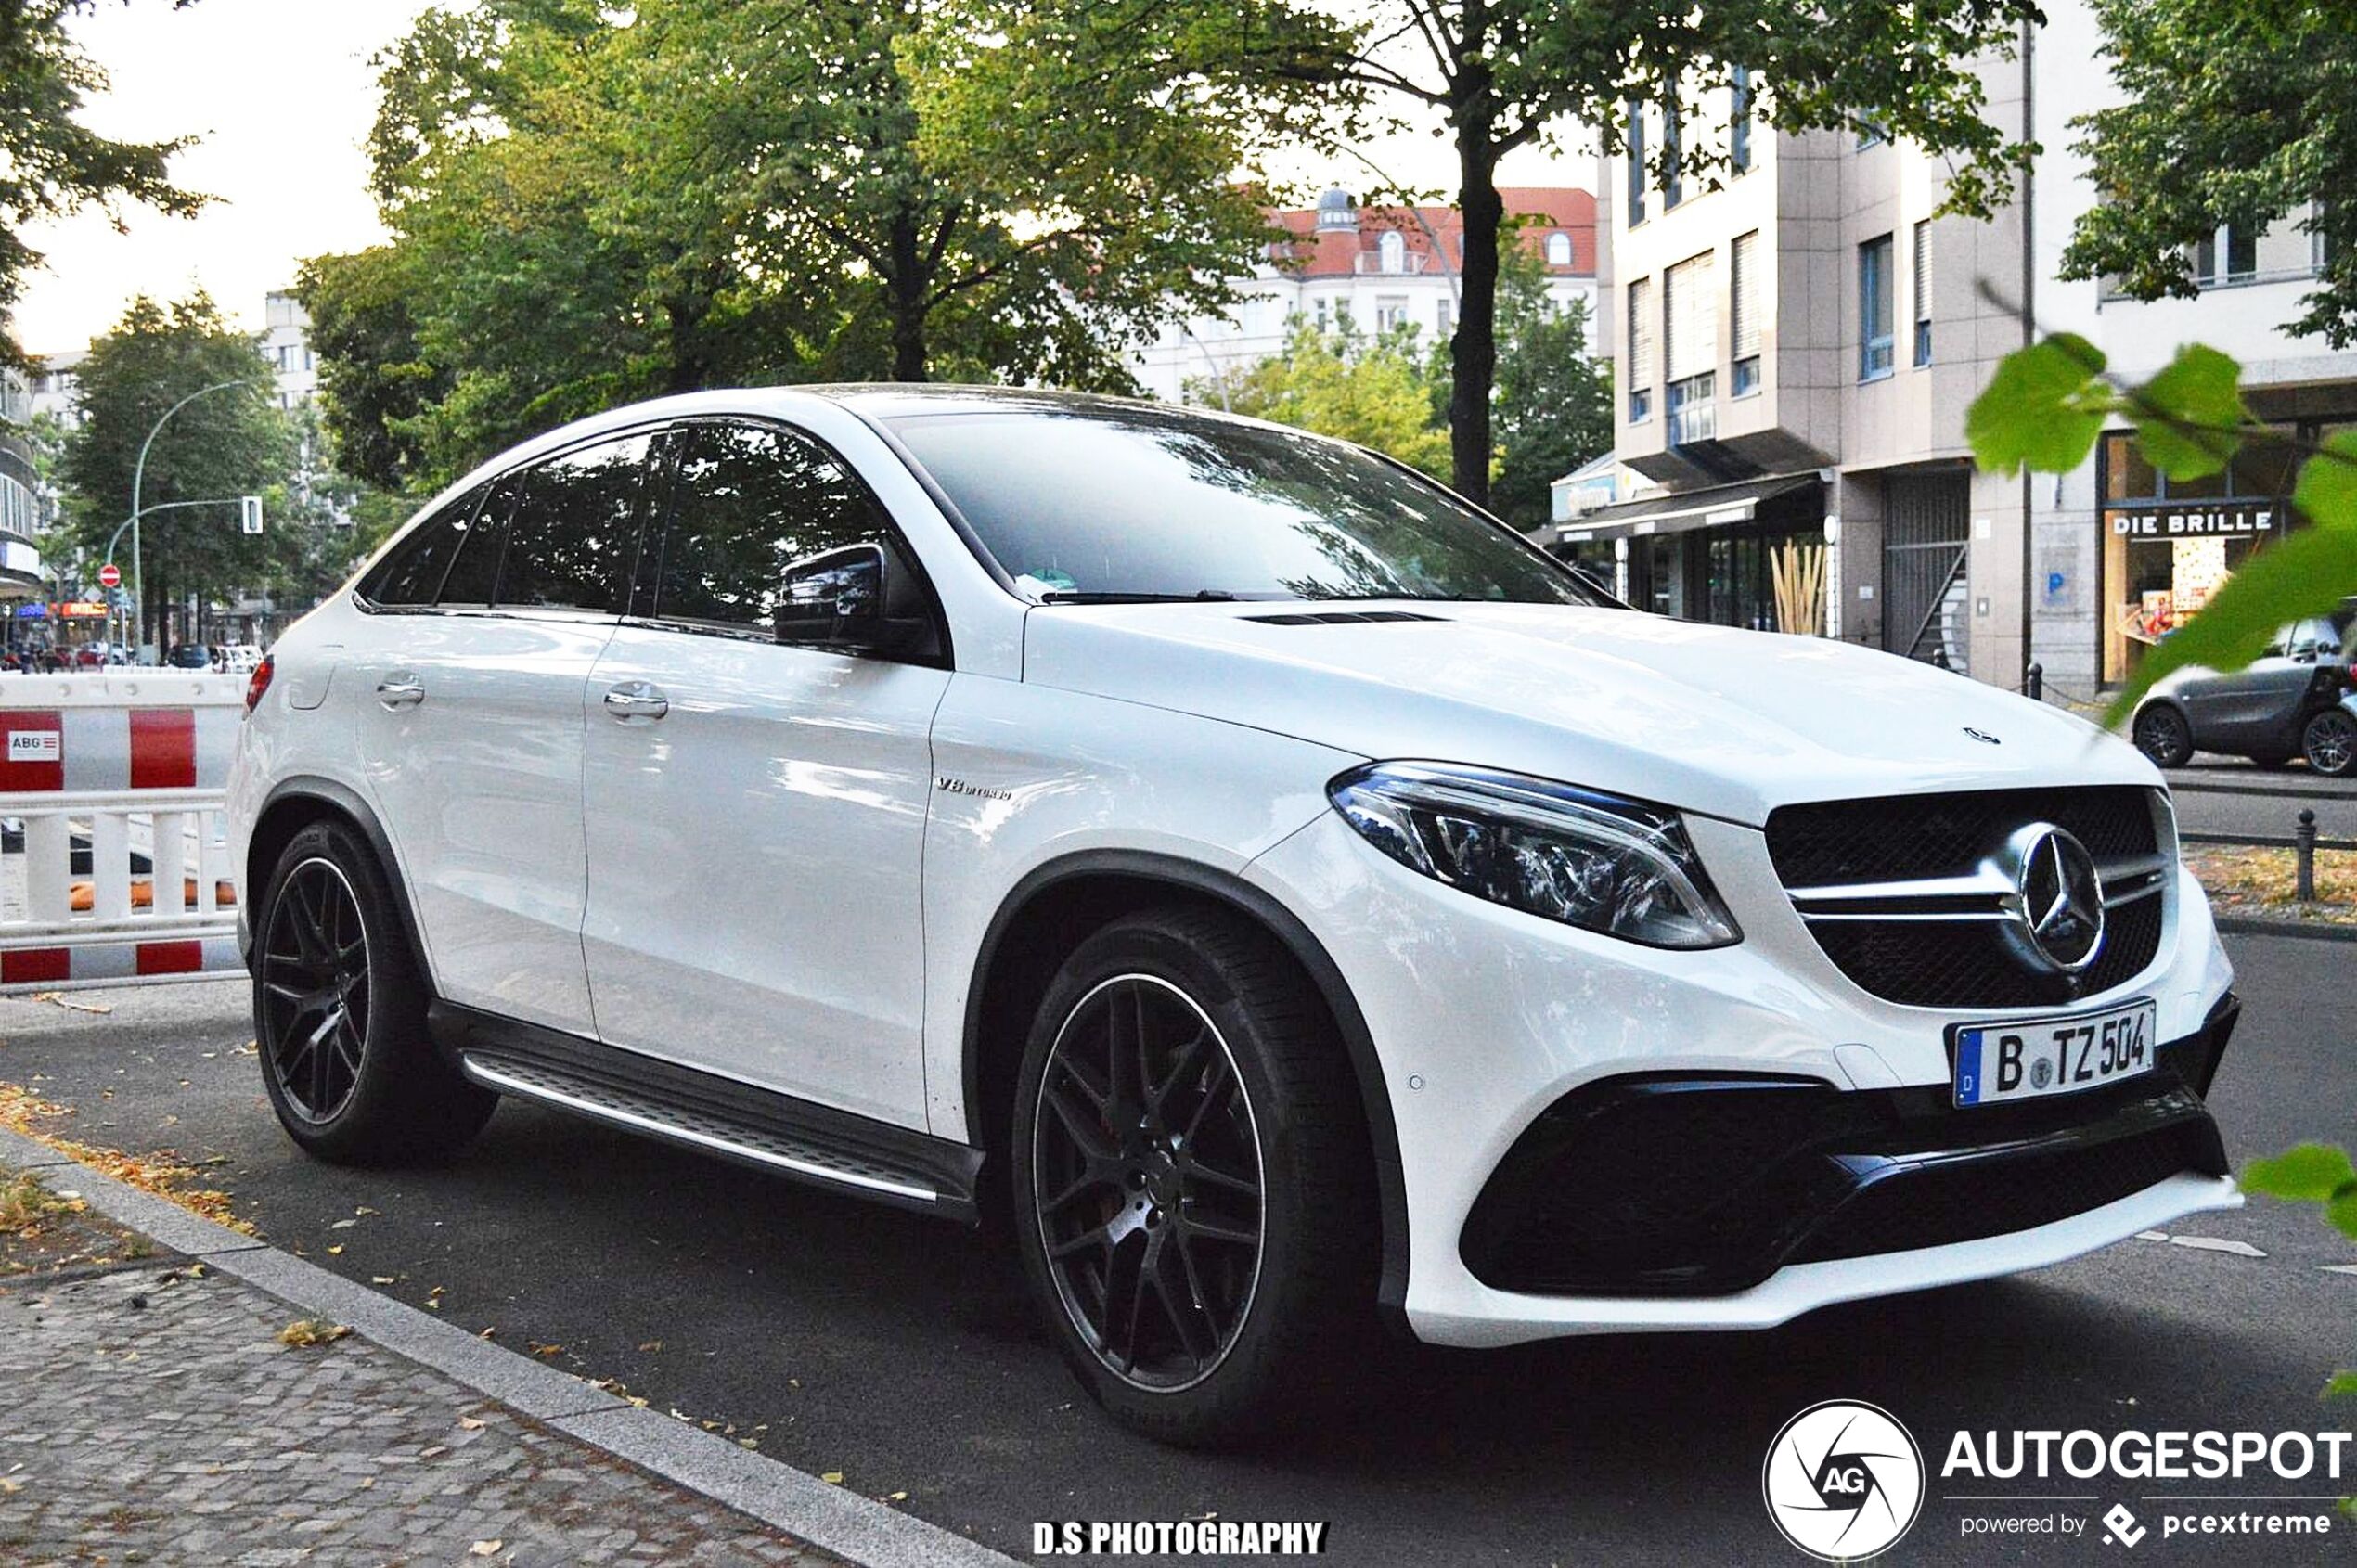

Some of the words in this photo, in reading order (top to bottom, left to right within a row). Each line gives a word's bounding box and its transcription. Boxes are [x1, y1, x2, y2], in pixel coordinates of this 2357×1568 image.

[2114, 516, 2157, 534] DIE
[2168, 512, 2272, 533] BRILLE
[13, 736, 40, 749] ABG
[1997, 1035, 2023, 1092] B
[2053, 1025, 2096, 1085] TZ
[2100, 1012, 2145, 1075] 504
[1964, 1075, 1973, 1091] D
